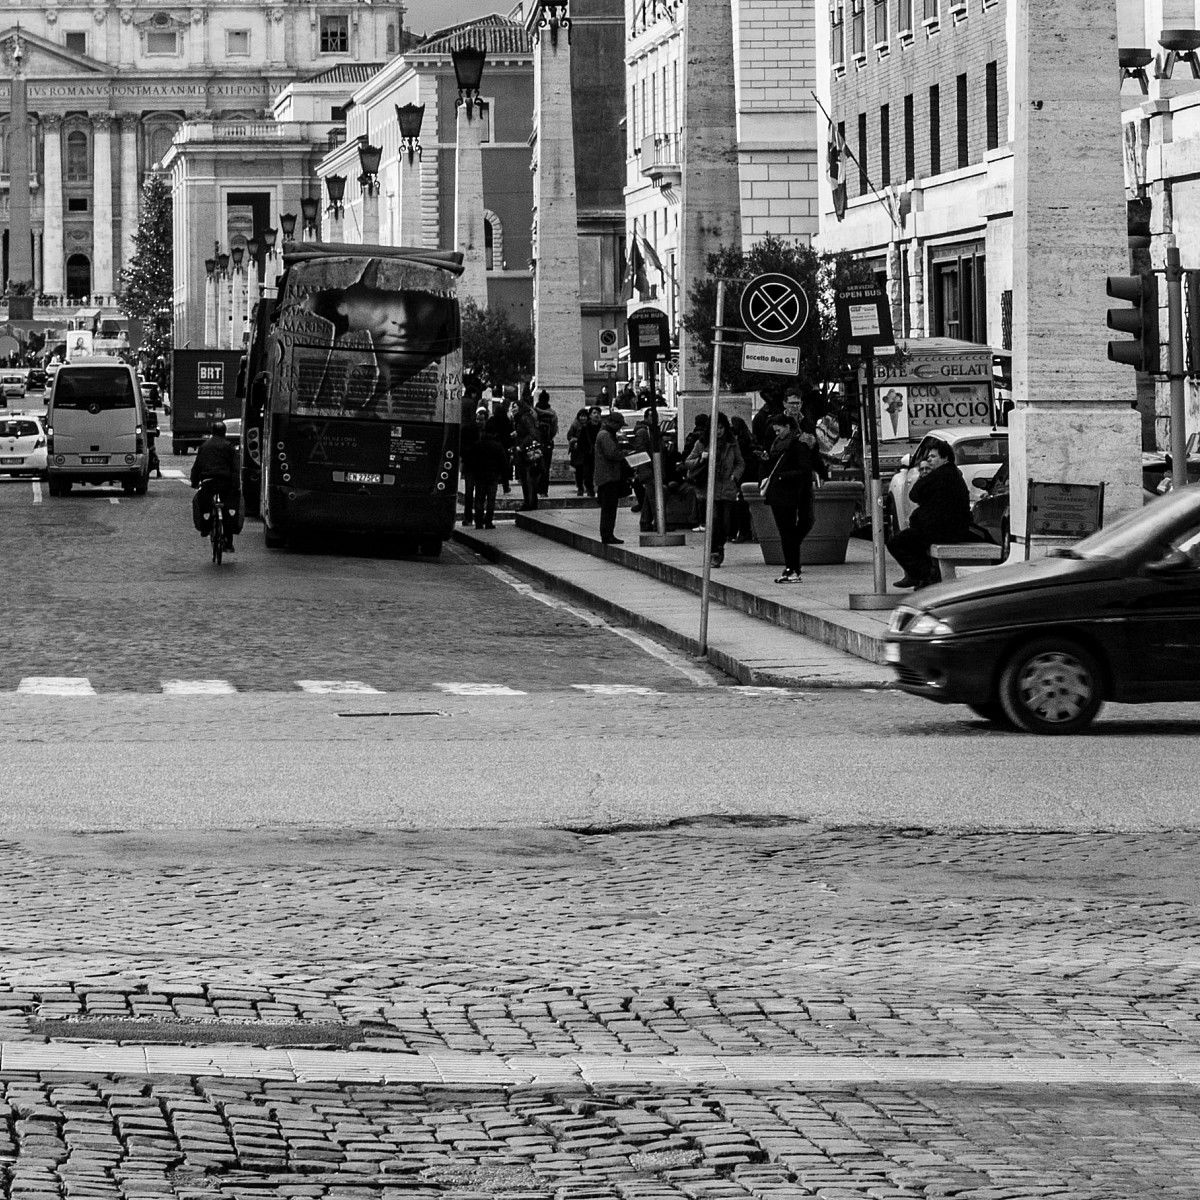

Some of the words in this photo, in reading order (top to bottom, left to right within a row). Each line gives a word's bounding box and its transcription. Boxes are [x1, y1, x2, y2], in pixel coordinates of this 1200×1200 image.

[49, 86, 109, 97] ROMANVS
[839, 290, 863, 299] OPEN
[864, 289, 882, 297] BUS
[745, 354, 770, 362] eccetto
[770, 355, 783, 363] Bus
[200, 367, 222, 379] BRT
[940, 364, 989, 377] GELATI
